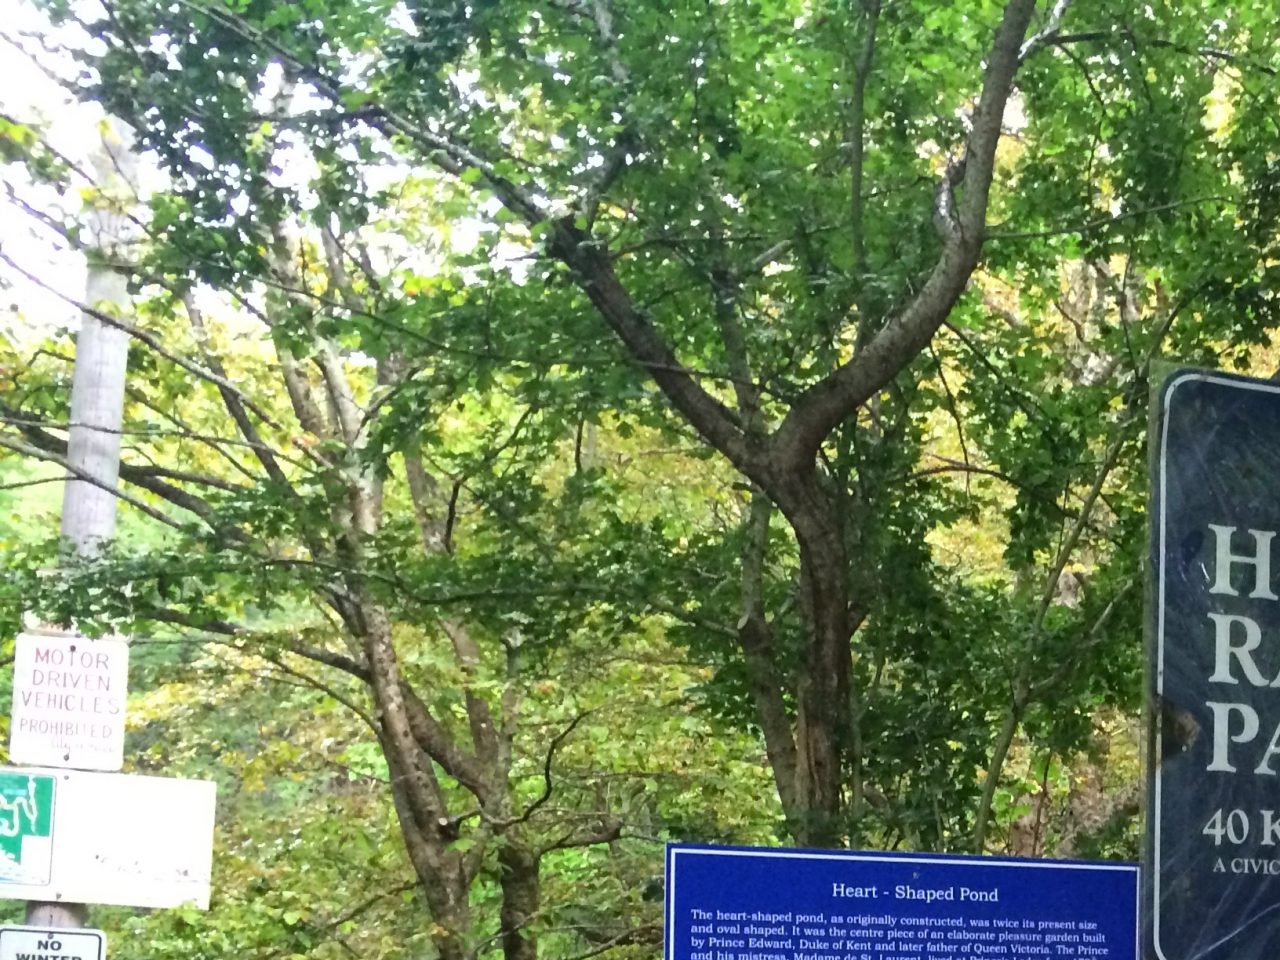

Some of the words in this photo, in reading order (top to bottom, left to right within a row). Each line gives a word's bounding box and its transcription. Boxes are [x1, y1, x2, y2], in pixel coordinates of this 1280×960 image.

[35, 647, 109, 670] MOTOR
[32, 669, 110, 691] DRIVEN
[22, 690, 119, 715] VEHICLES
[20, 718, 113, 738] PROHIBITED
[1203, 809, 1249, 846] 40
[1213, 861, 1226, 874] A
[832, 883, 877, 898] Heart
[895, 884, 954, 904] Shaped
[960, 886, 998, 901] Pond
[690, 909, 712, 920] The
[716, 910, 792, 925] heart-shaped
[795, 911, 827, 925] pond,
[830, 915, 843, 923] as
[846, 912, 897, 927] originally
[900, 914, 966, 928] constructed,
[969, 919, 989, 927] was
[992, 916, 1019, 928] twice
[1022, 917, 1034, 928] its
[1038, 918, 1075, 932] present
[1078, 919, 1097, 930] size
[690, 924, 713, 934] and
[716, 924, 740, 935] oval
[743, 924, 787, 938] shaped.
[792, 925, 800, 936] It
[803, 928, 825, 936] was
[828, 926, 846, 937] the
[849, 926, 883, 938] centre
[887, 927, 914, 941] piece
[917, 928, 928, 938] of
[930, 931, 944, 939] an
[947, 928, 995, 940] elaborate
[998, 930, 1042, 944] pleasure
[1044, 931, 1079, 945] garden
[1082, 932, 1105, 943] built
[37, 940, 62, 951] NO
[690, 937, 704, 950] by
[708, 937, 744, 948] Prince
[748, 937, 795, 951] Edward,
[799, 938, 829, 949] Duke
[832, 938, 843, 949] of
[846, 939, 871, 950] Kent
[874, 939, 895, 950] and
[898, 940, 923, 951] later
[926, 940, 957, 952] father
[960, 941, 972, 952] of
[973, 941, 1007, 954] Queen
[1010, 942, 1052, 954] Victoria.
[1056, 943, 1074, 954] The
[1077, 944, 1108, 955] Prince
